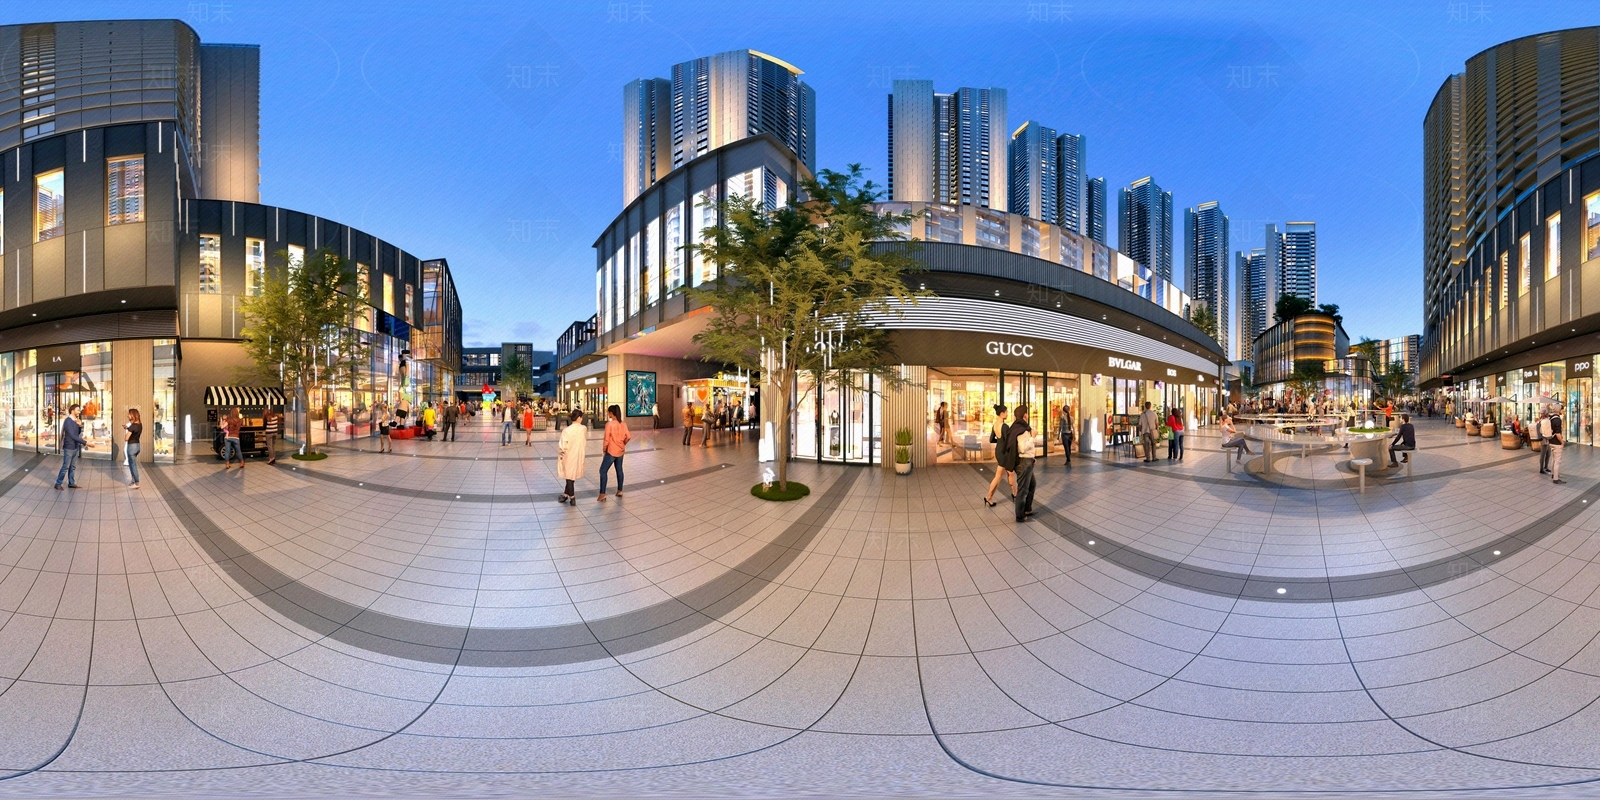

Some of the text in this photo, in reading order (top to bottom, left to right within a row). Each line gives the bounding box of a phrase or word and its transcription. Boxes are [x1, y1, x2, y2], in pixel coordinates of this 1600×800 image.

[986, 341, 1034, 358] GUCC
[1108, 356, 1142, 371] BVLGAR
[1574, 361, 1590, 372] ppo
